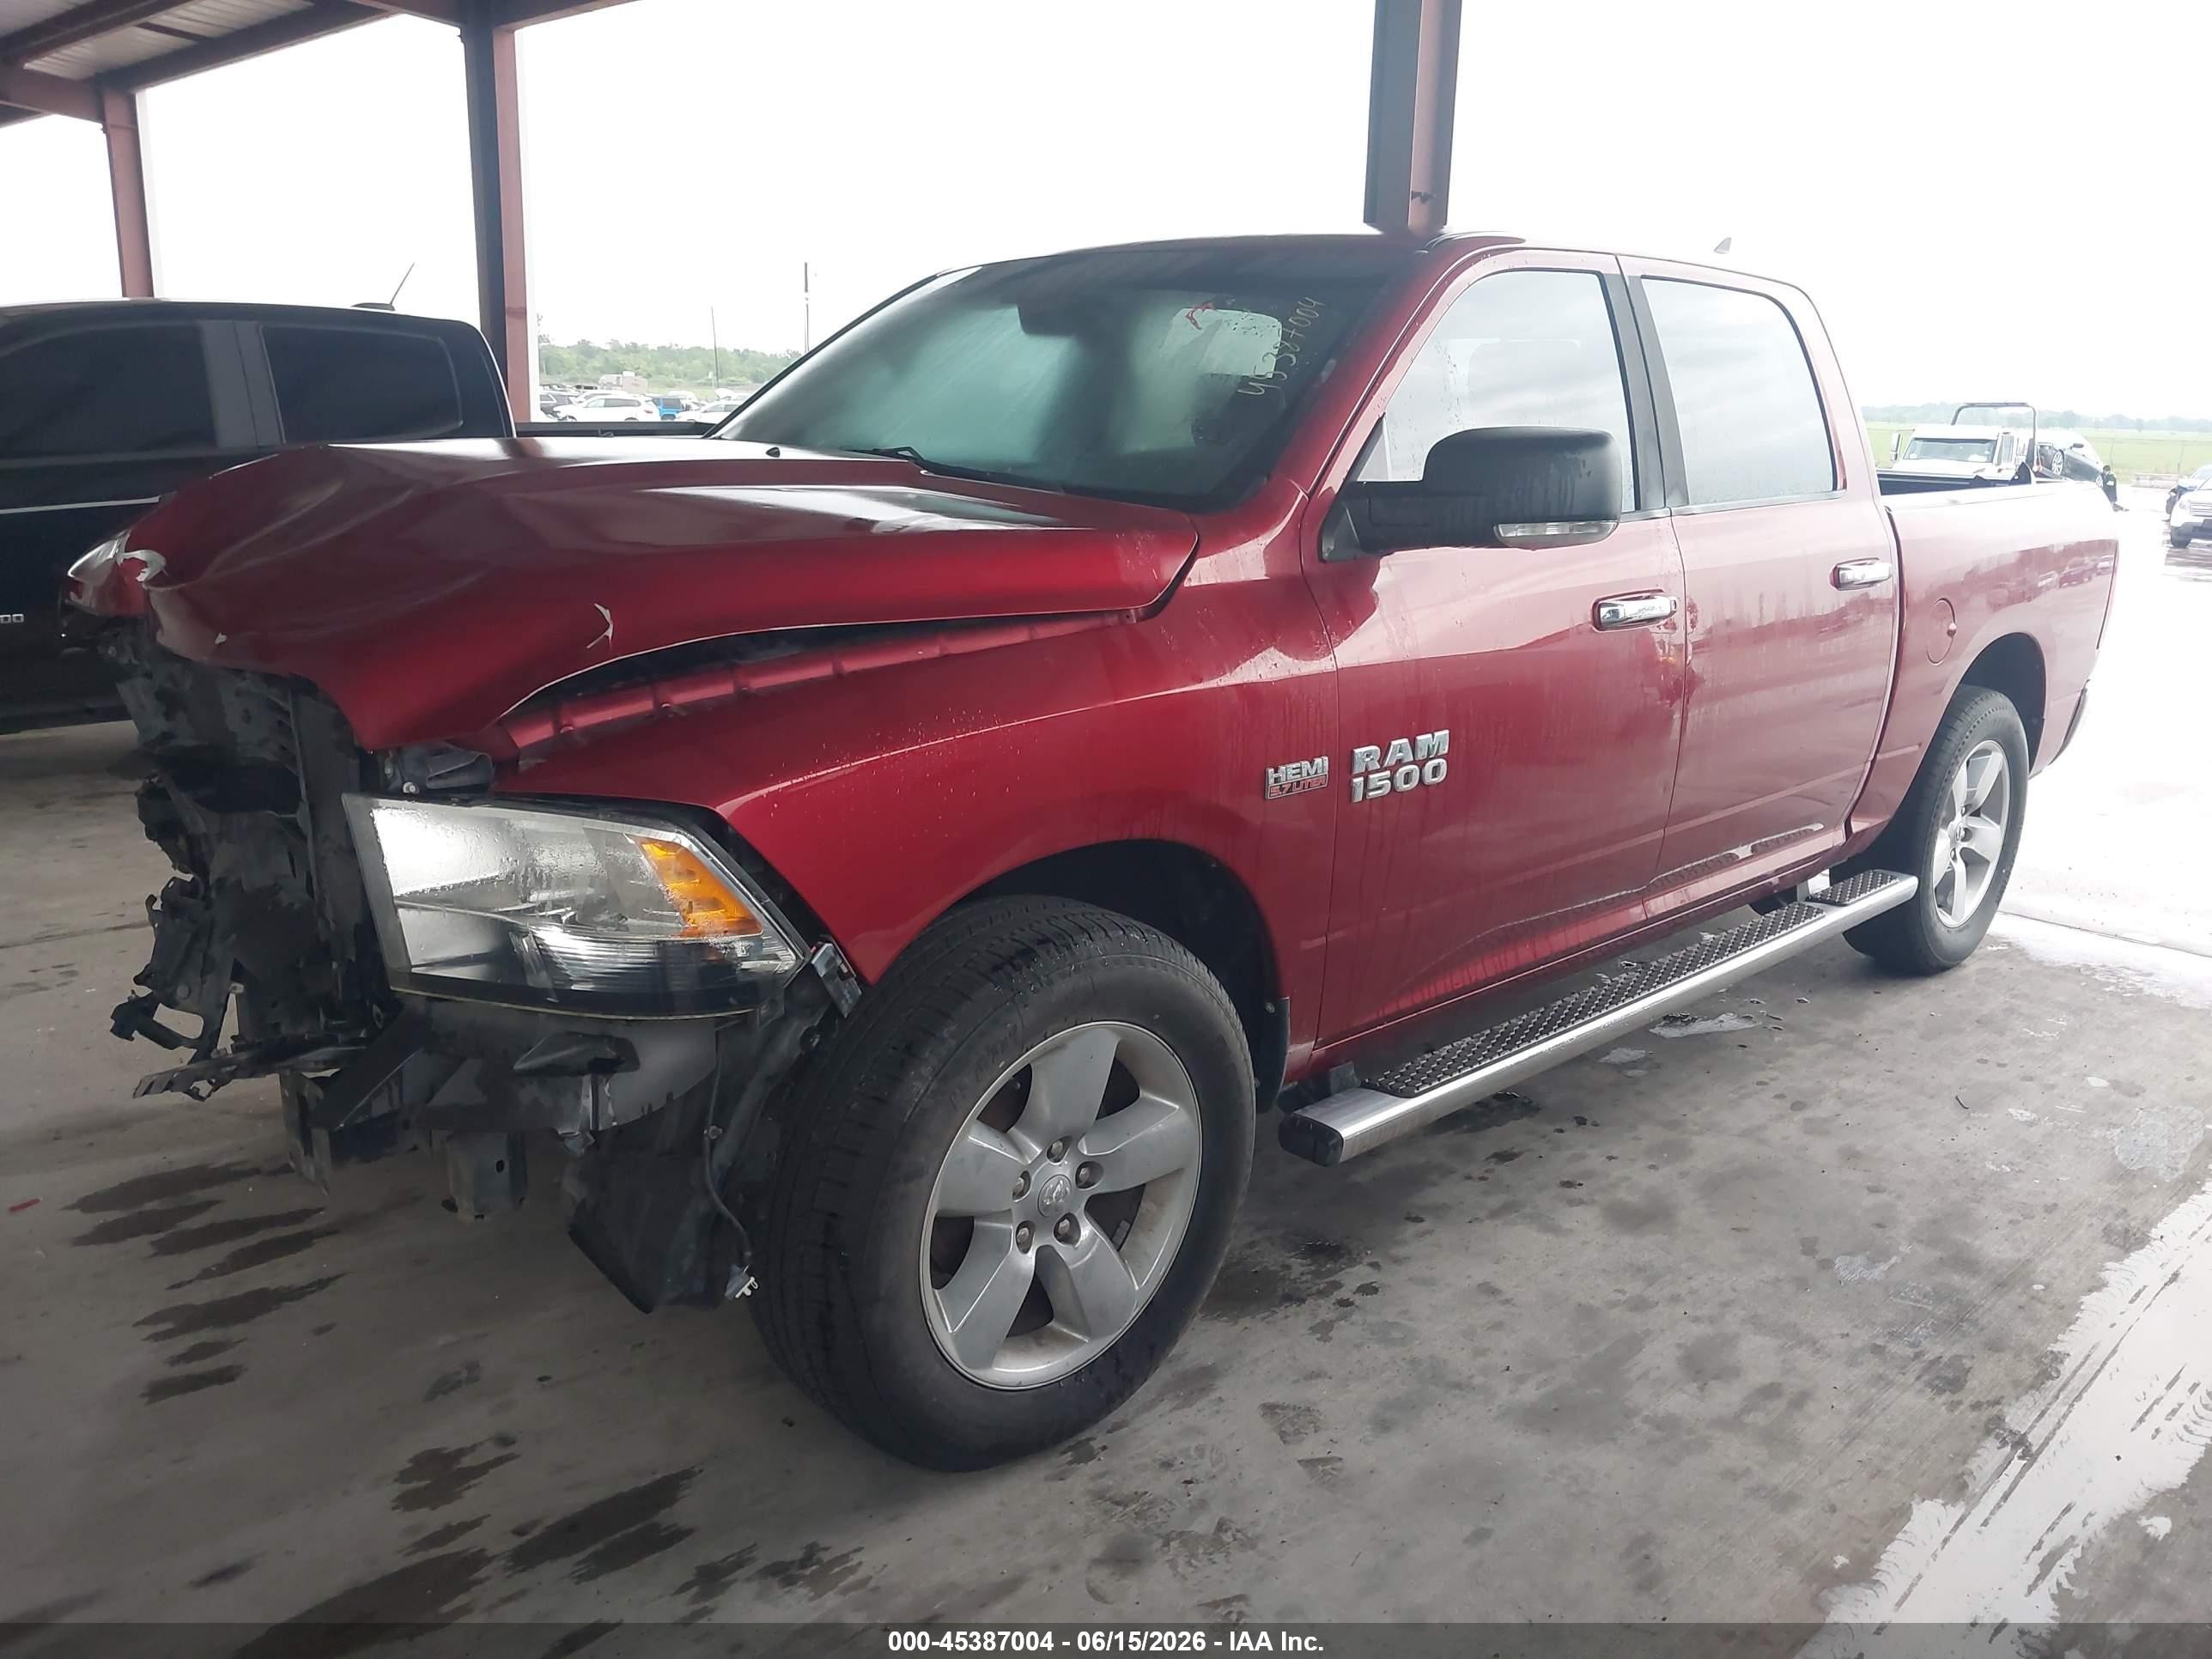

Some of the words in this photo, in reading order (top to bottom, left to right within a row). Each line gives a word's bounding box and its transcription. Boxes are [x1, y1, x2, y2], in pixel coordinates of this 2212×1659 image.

[1267, 756, 1329, 785] HEMI
[1352, 729, 1449, 775] RAM
[1269, 782, 1291, 797] 5.7
[1292, 775, 1327, 793] LITER
[1352, 758, 1448, 803] 1500
